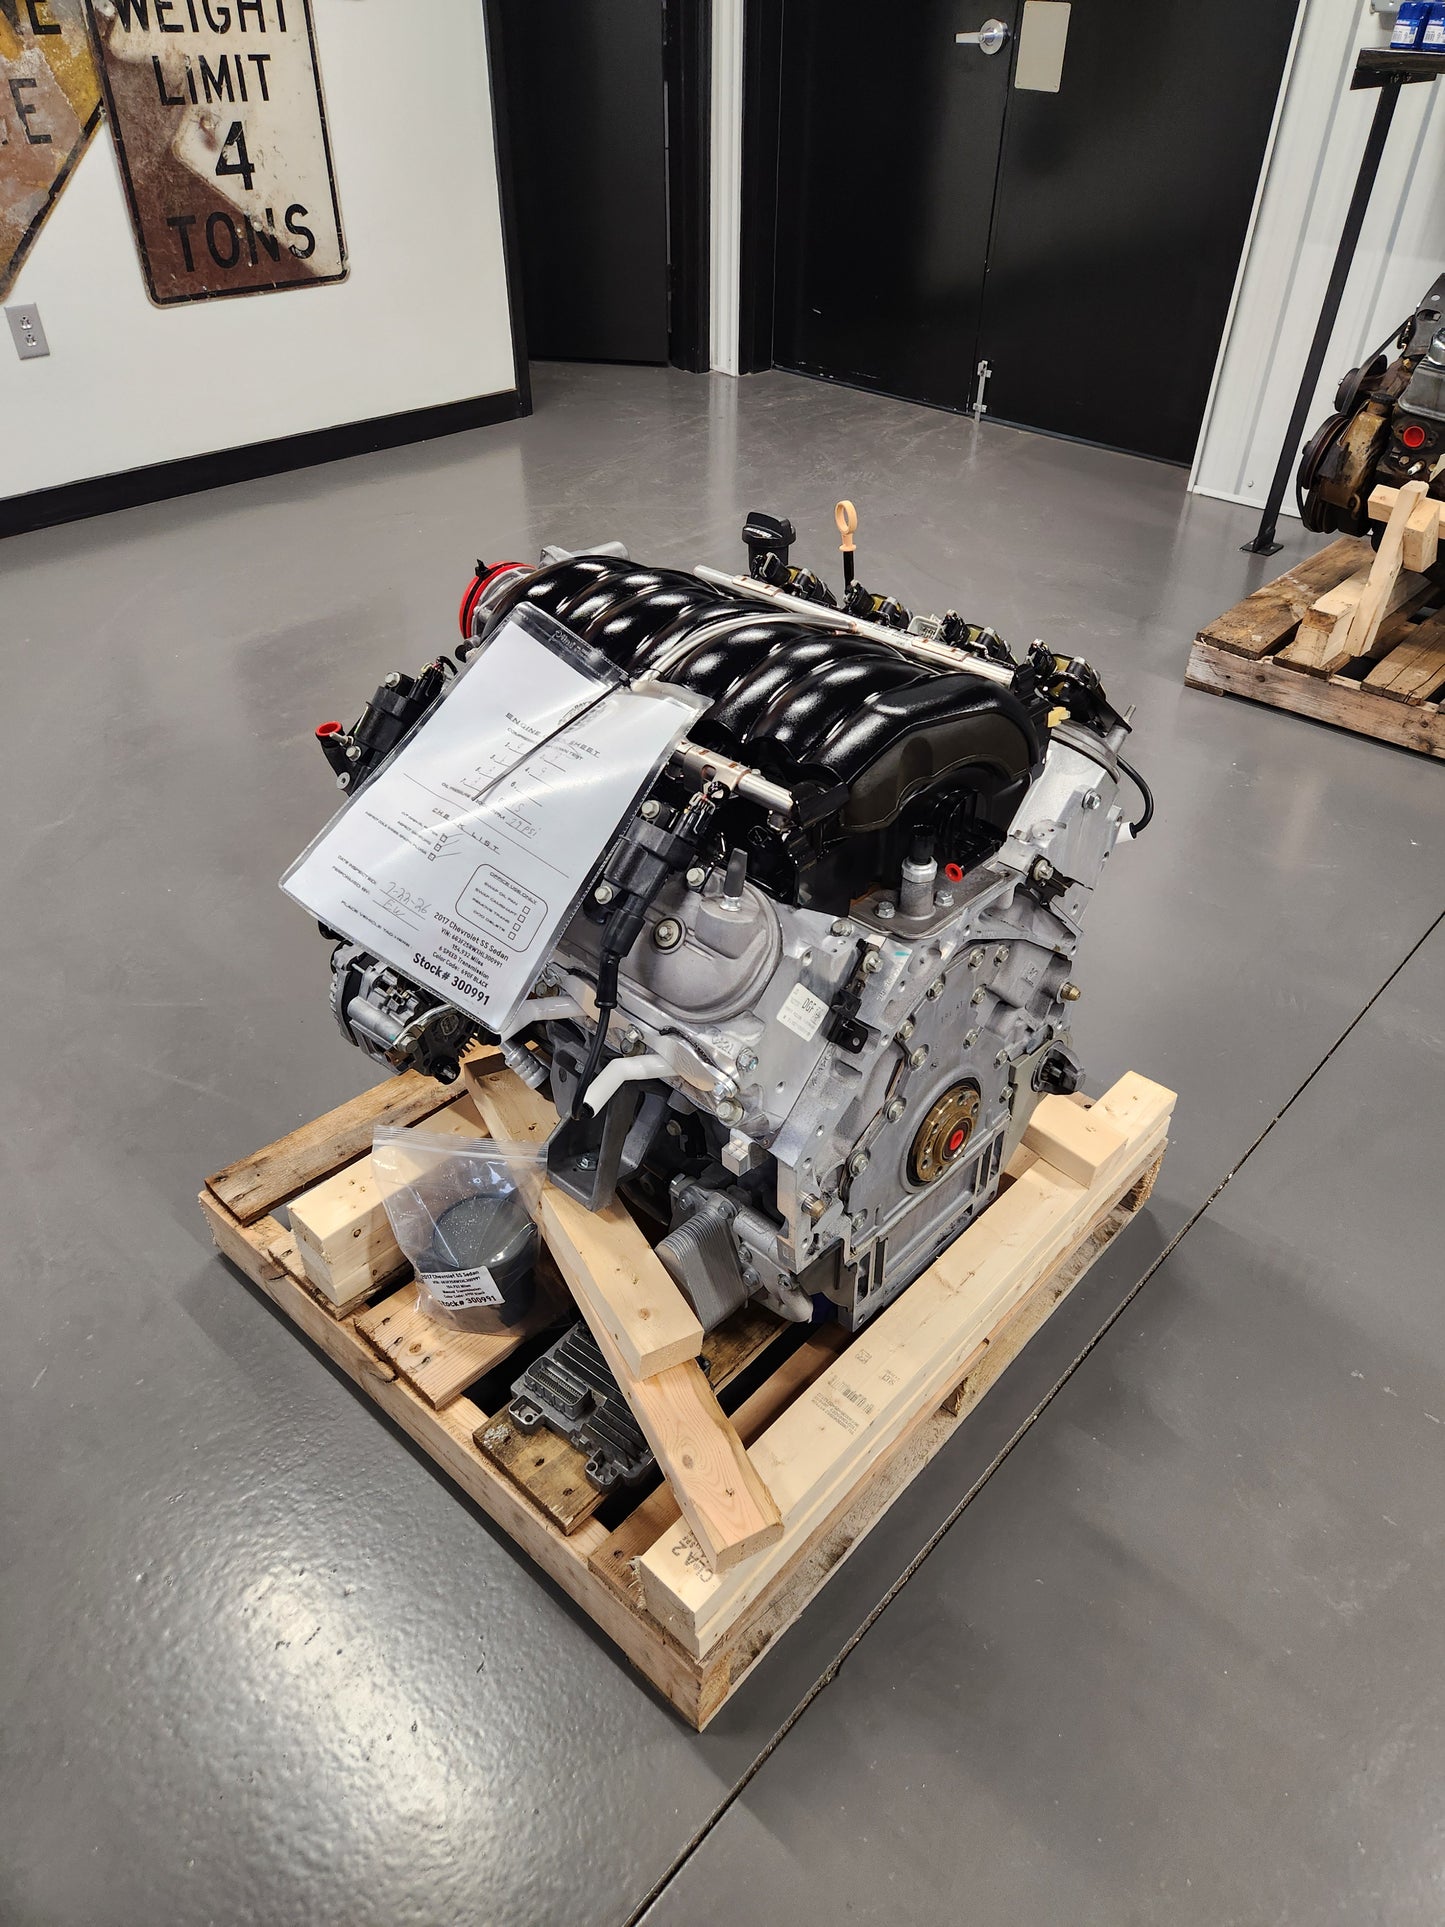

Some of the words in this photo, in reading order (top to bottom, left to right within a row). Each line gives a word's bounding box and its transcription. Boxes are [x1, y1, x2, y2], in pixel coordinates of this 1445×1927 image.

[0, 0, 62, 34] E
[114, 0, 287, 34] WEIGHT
[151, 54, 271, 105] LIMIT
[0, 78, 53, 144] E
[215, 121, 255, 190] 4
[167, 203, 316, 272] TONS
[470, 831, 499, 852] LIST
[433, 911, 449, 925] 2017
[448, 920, 480, 944] Chevrolet
[479, 939, 490, 949] SS
[488, 944, 509, 961] Sedan
[431, 951, 446, 963] Color
[445, 959, 460, 971] Code:
[472, 975, 488, 988] BLACK
[442, 948, 458, 960] SPEED
[456, 957, 490, 980] Transmission
[469, 954, 484, 966] Miles
[411, 952, 451, 982] Stock#
[450, 975, 490, 1006] 300991
[466, 1296, 496, 1304] 300991
